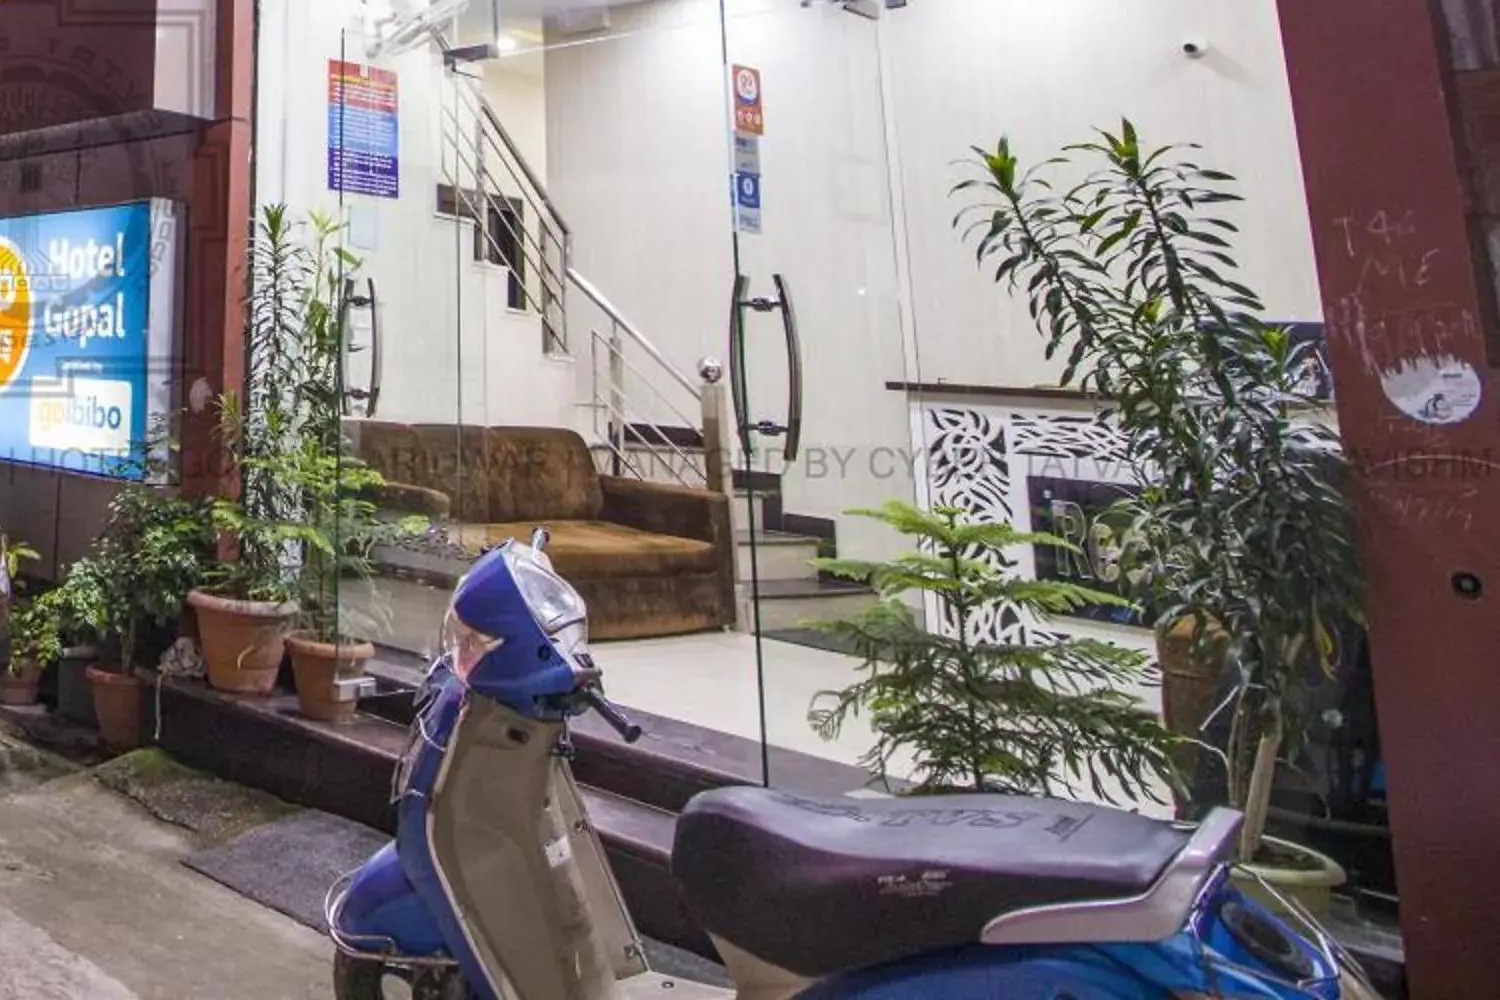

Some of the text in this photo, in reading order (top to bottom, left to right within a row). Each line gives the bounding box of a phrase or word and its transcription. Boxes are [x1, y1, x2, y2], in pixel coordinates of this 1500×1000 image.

[49, 232, 125, 277] Hotel
[43, 292, 125, 348] Gopal
[39, 395, 121, 431] goibibo
